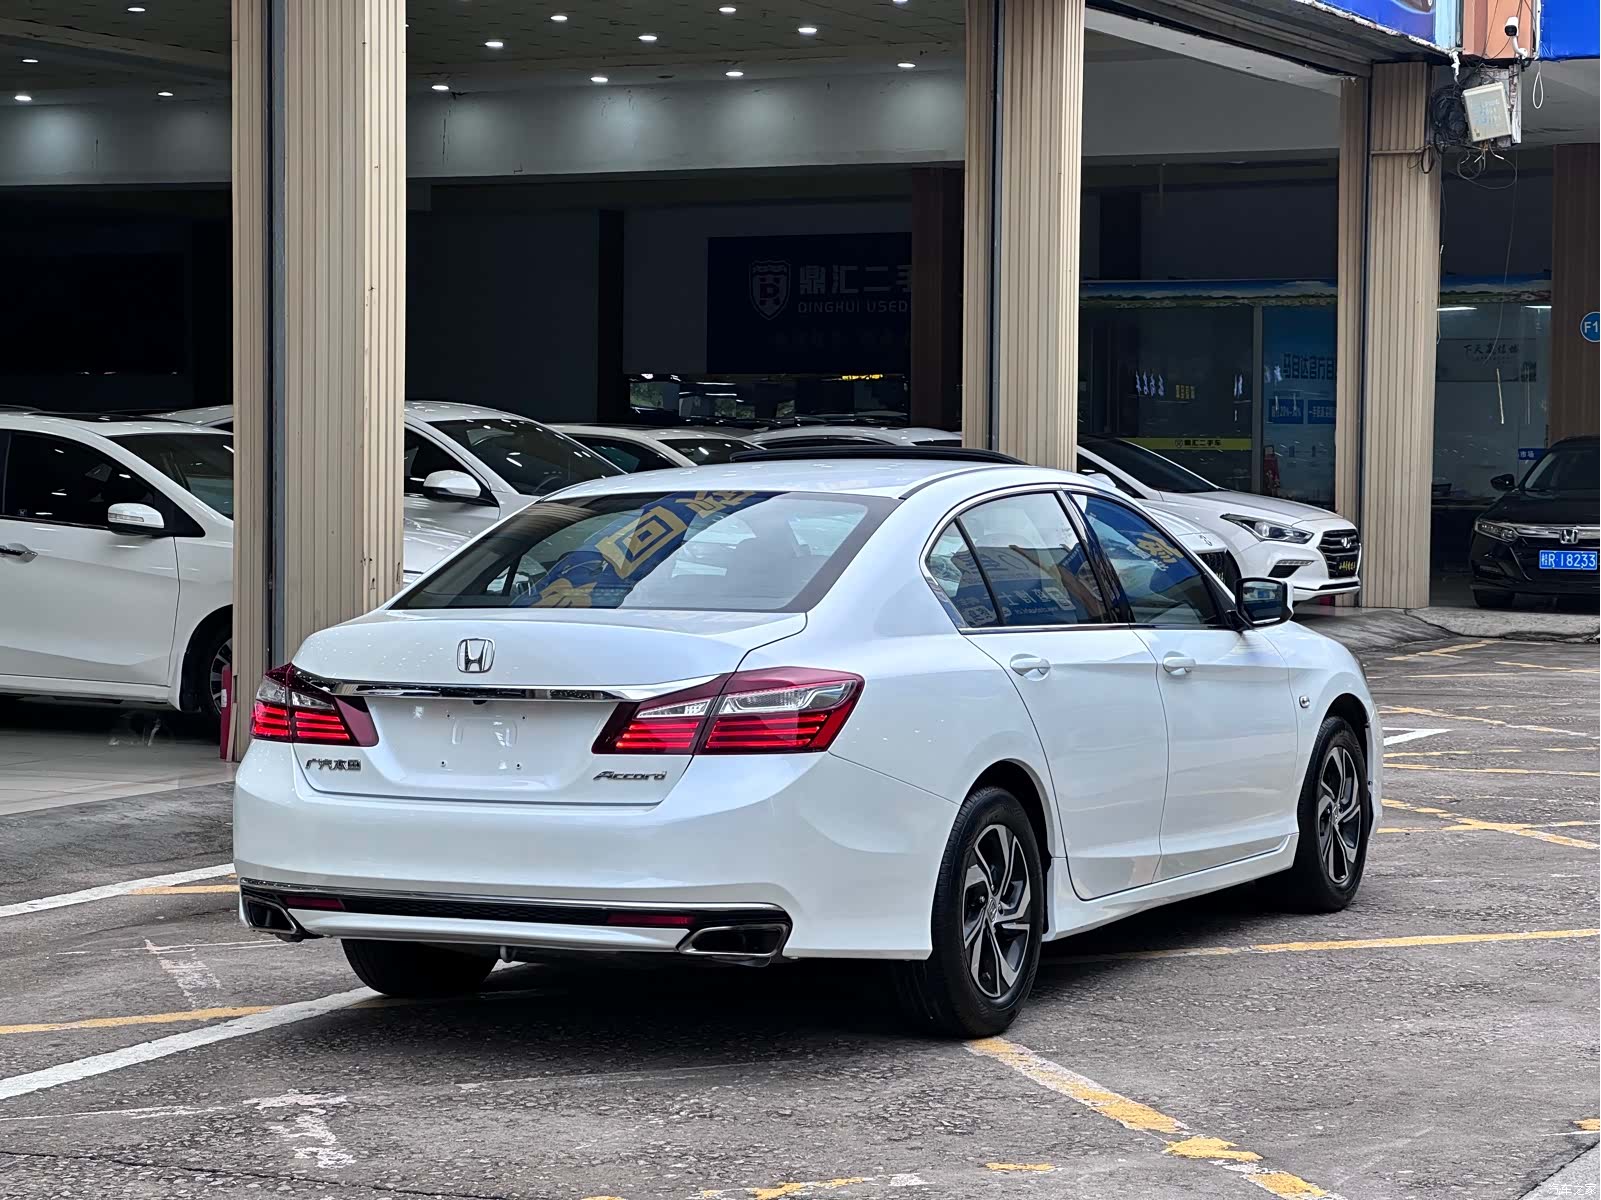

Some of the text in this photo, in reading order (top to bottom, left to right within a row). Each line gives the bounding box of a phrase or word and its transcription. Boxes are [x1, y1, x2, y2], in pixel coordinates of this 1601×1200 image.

[798, 300, 908, 313] DINGHUI USED
[305, 758, 362, 771] 广汽本田
[592, 770, 668, 783] Accord
